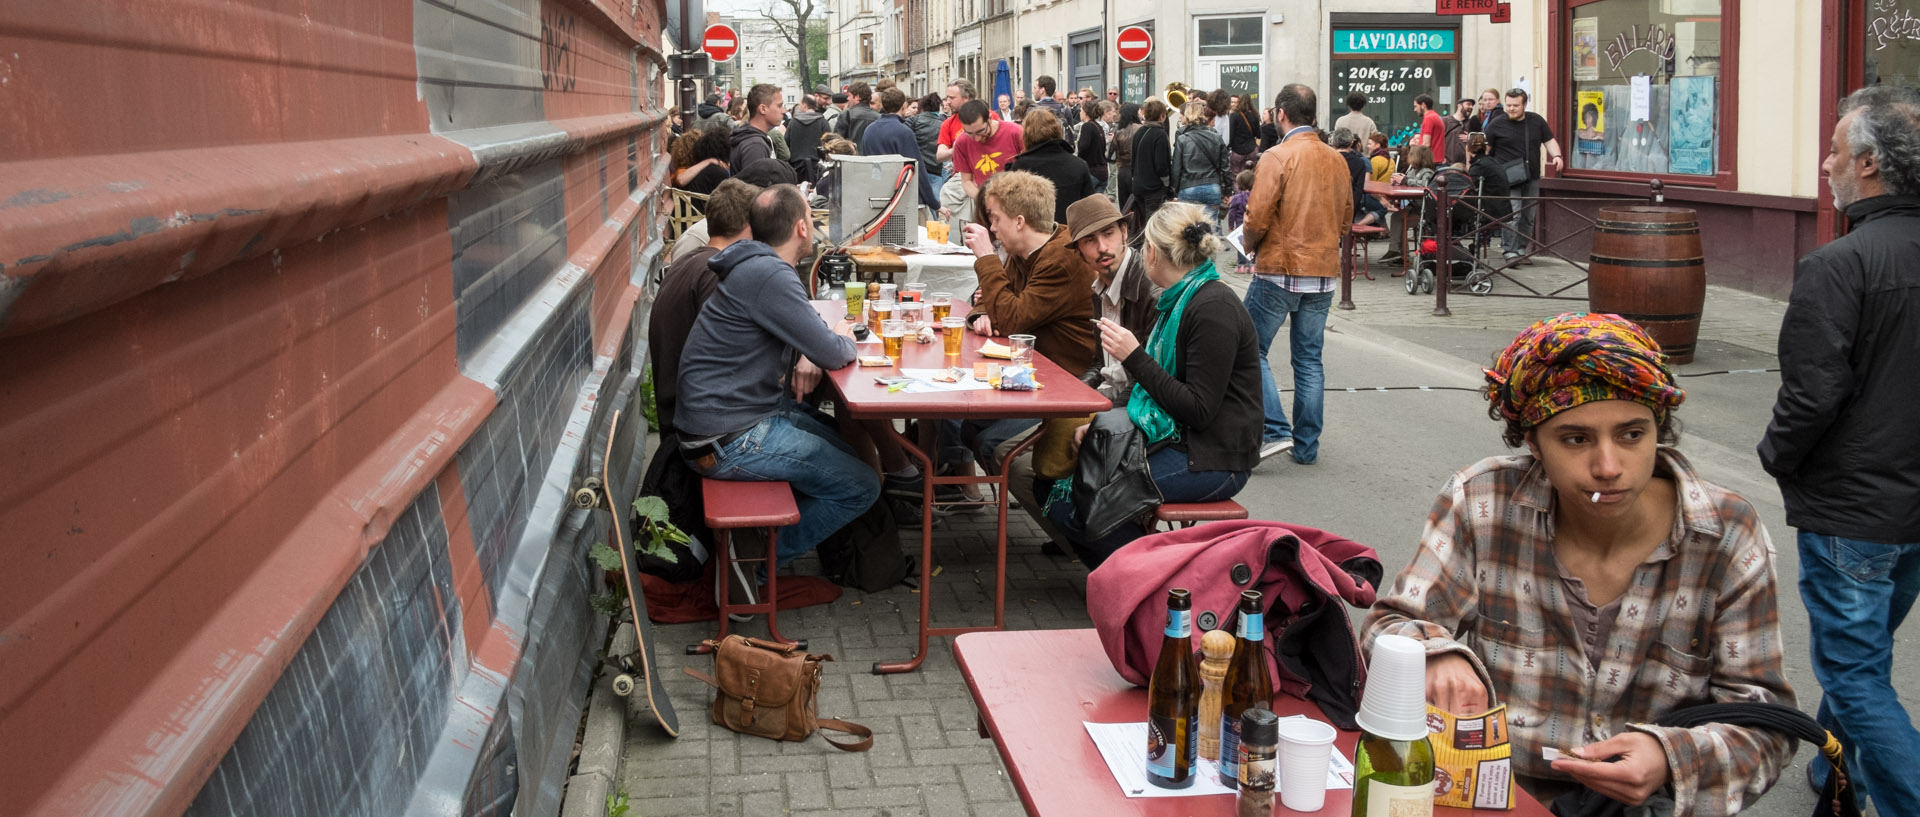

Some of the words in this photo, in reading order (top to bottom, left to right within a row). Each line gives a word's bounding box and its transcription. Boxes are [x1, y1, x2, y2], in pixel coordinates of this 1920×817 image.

[1604, 23, 1676, 72] BILLARD
[1348, 67, 1394, 81] 20Kg:
[1399, 67, 1433, 79] 7.80
[1348, 82, 1376, 94] 7Kg:
[1379, 82, 1405, 92] 4.00
[1368, 96, 1386, 104] 3.30
